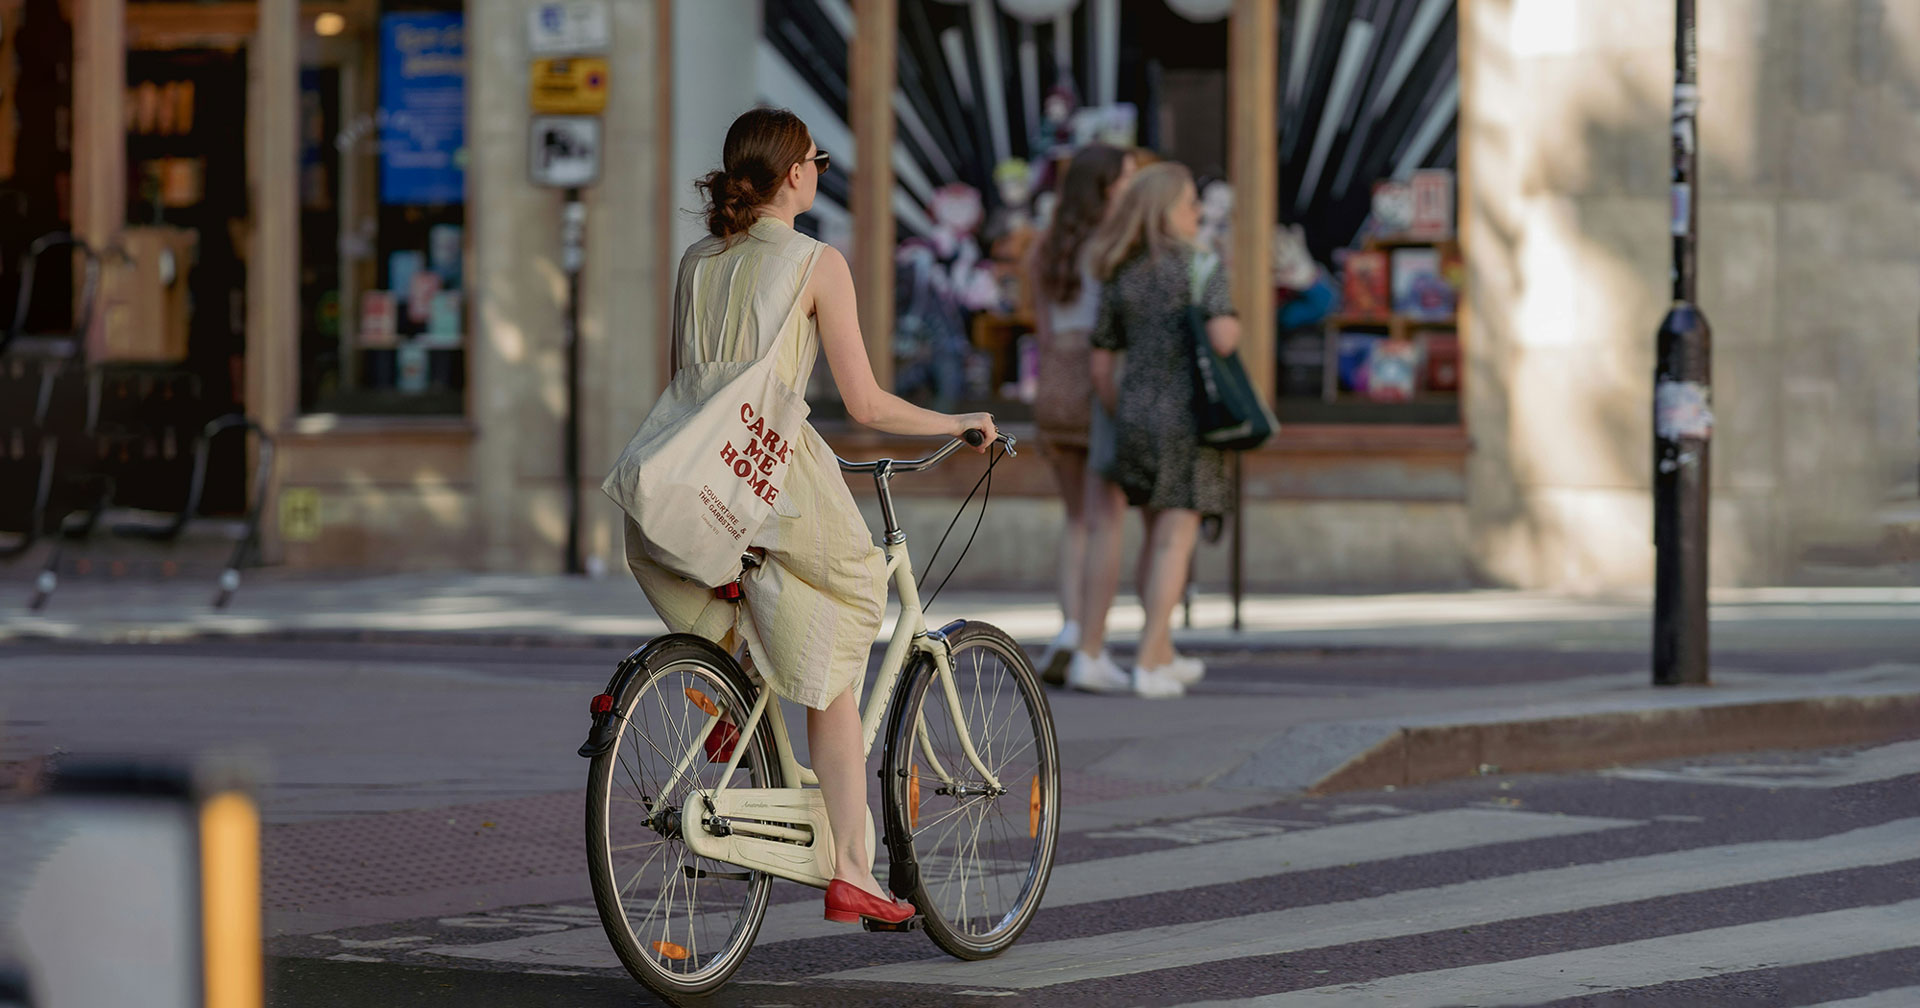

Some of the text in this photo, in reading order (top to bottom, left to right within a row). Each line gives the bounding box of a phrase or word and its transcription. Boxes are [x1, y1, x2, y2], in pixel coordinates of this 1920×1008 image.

[740, 402, 794, 466] CARR
[742, 438, 777, 476] ME
[720, 440, 779, 506] HOME
[698, 490, 742, 541] THE GARBSTORE
[703, 484, 747, 535] COUVERTURE &
